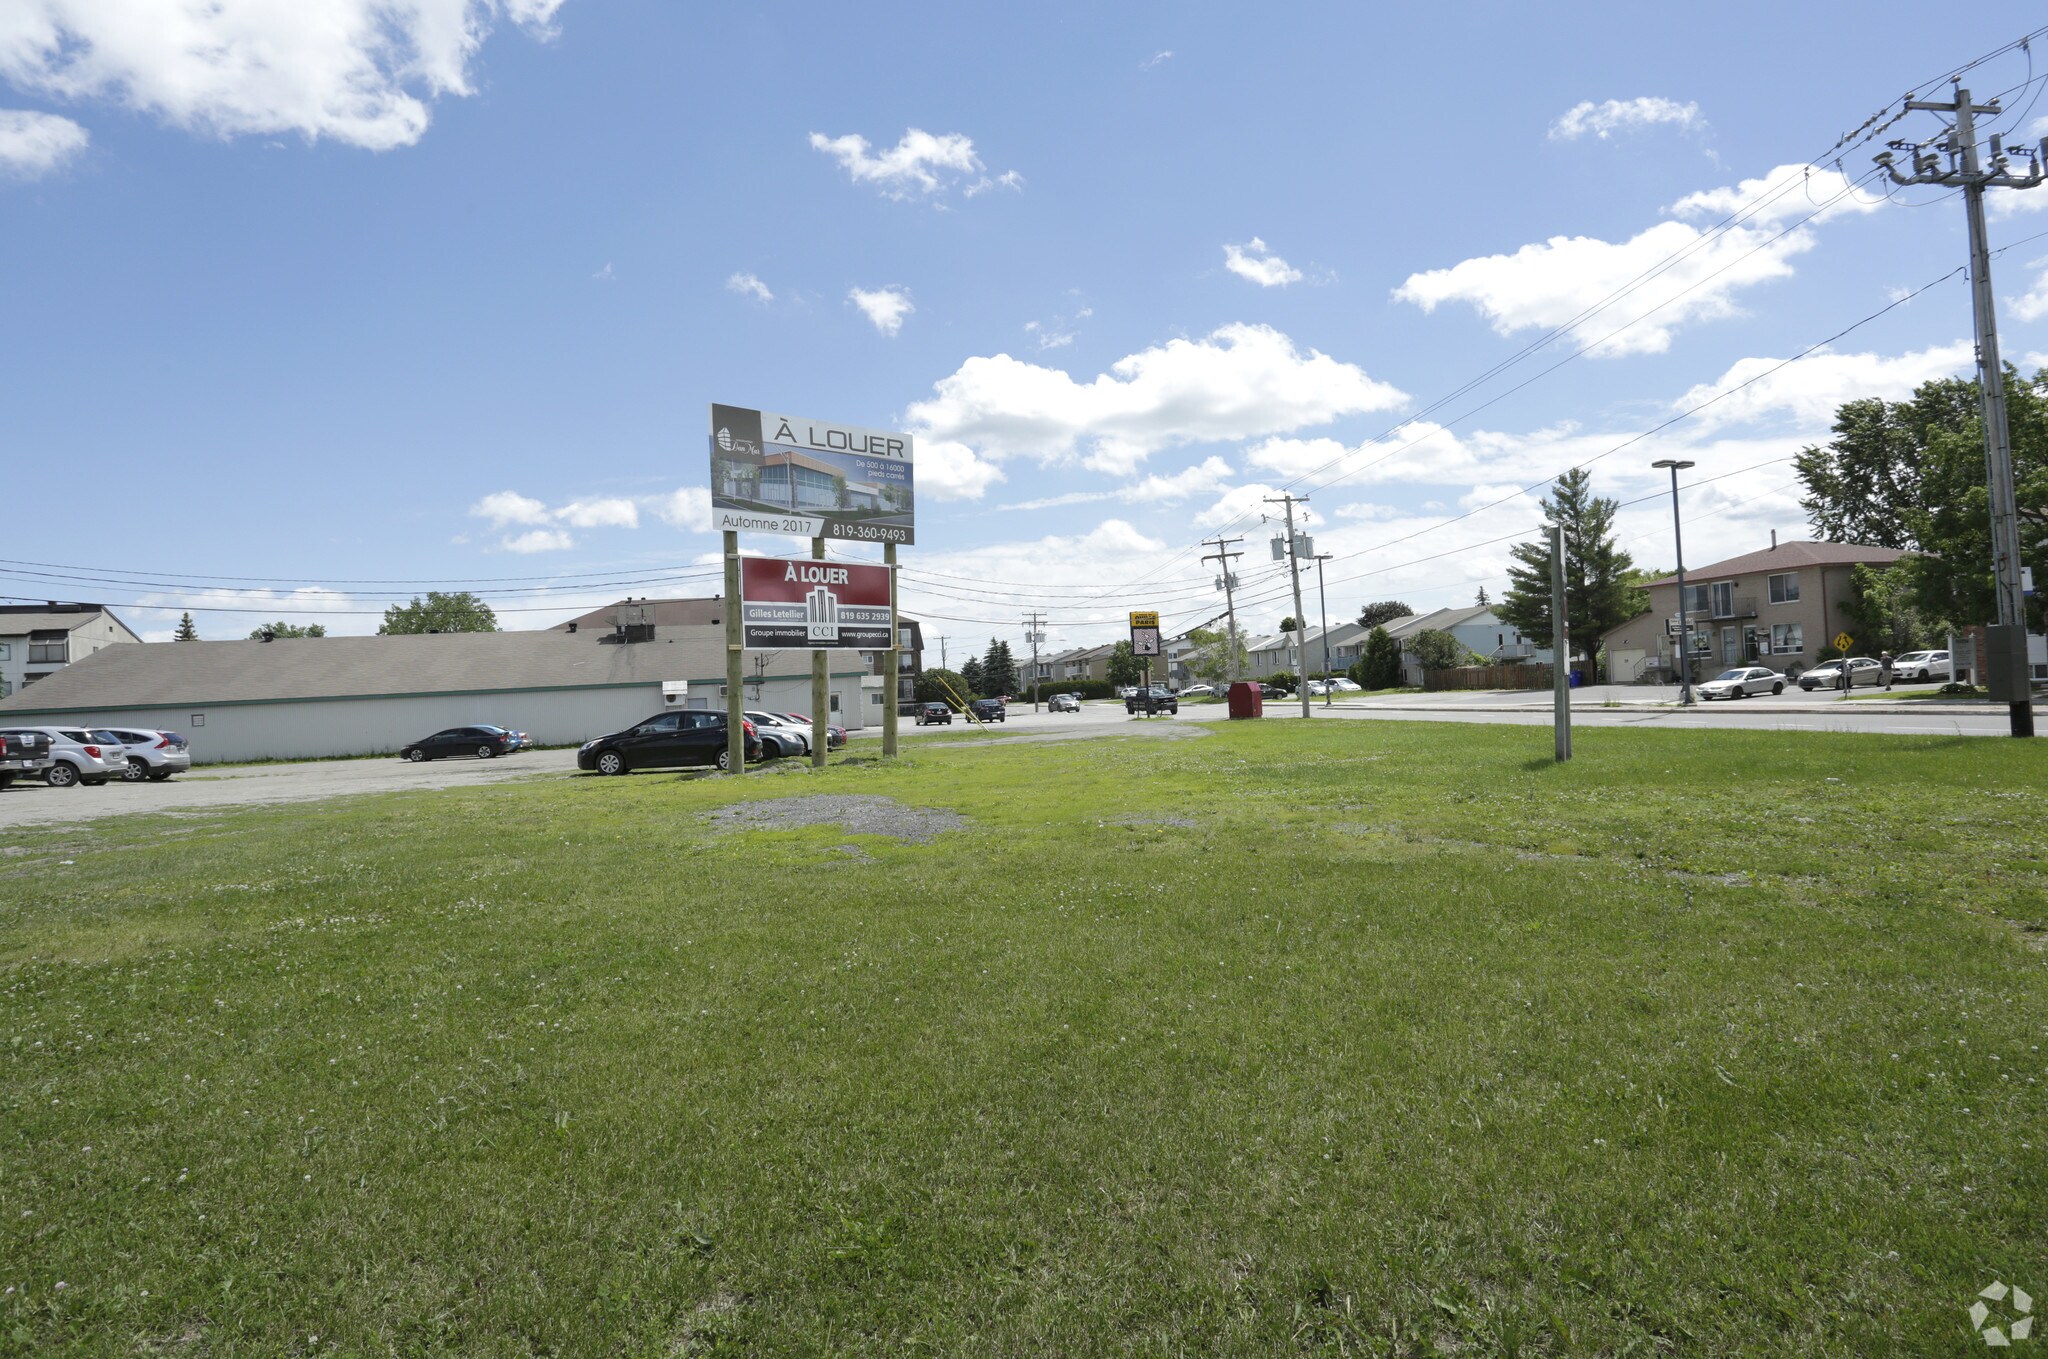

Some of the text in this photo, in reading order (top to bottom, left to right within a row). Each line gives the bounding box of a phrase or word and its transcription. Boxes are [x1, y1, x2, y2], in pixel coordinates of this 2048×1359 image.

[774, 417, 904, 458] À LOUER
[856, 459, 905, 473] De 500 à 16000
[868, 469, 905, 480] pieds carrés
[722, 514, 811, 533] Automne 2017
[833, 524, 906, 541] 819-360-9493
[784, 562, 848, 585] À LOUER
[749, 609, 805, 619] Gilles Letellier
[840, 612, 890, 621] 819 635 2939
[750, 629, 806, 638] Groupe immobilier
[812, 626, 834, 637] CCI
[841, 630, 889, 639] www.groupecci.ca
